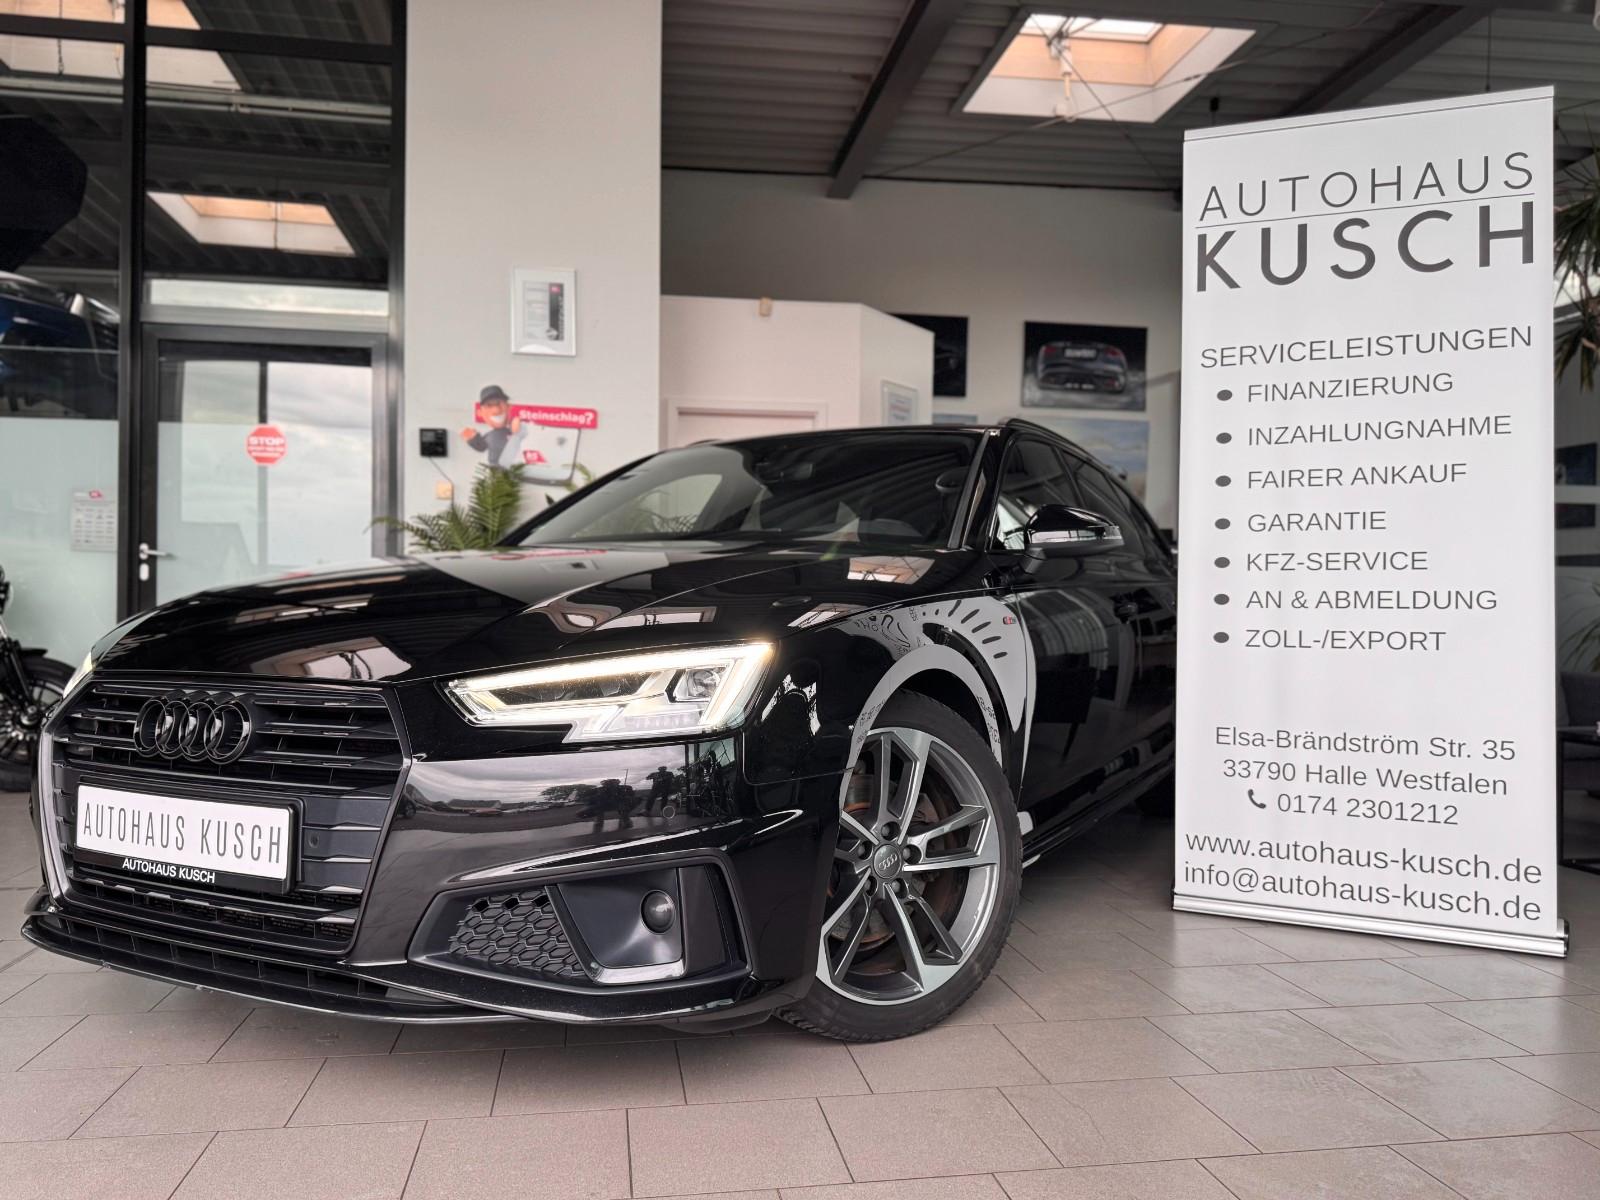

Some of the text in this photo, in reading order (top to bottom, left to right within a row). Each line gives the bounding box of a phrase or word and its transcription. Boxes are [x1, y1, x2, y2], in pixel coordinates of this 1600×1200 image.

[1199, 152, 1533, 222] AUTOHAUS
[1197, 201, 1534, 292] KUSCH
[1201, 325, 1532, 368] SERVICELEISTUNGEN
[1248, 372, 1453, 403] FINANZIERUNG
[519, 409, 595, 425] Steinschlag?
[1248, 415, 1512, 446] INZAHLUNGNAHME
[249, 436, 285, 446] STOP
[1248, 463, 1467, 489] FAIRER ANKAUF
[1248, 511, 1386, 532] GARANTIE
[1247, 551, 1428, 572] KFZ-SERVICE
[1246, 591, 1497, 609] AN & ABMELDUNG
[1245, 630, 1446, 650] ZOLL-/EXPORT
[1216, 726, 1515, 760] Elsa-Brändström Str. 35
[1223, 759, 1507, 795] 33790 Halle Westfalen
[1277, 793, 1458, 825] 0174 2301212
[84, 803, 280, 863] AUTOHAUS KUSCH
[122, 858, 215, 883] AUTOHAUS KUSCH
[1186, 834, 1542, 884] www.autohaus-kusch.de
[1185, 861, 1541, 921] info@autohaus-kusch.de
